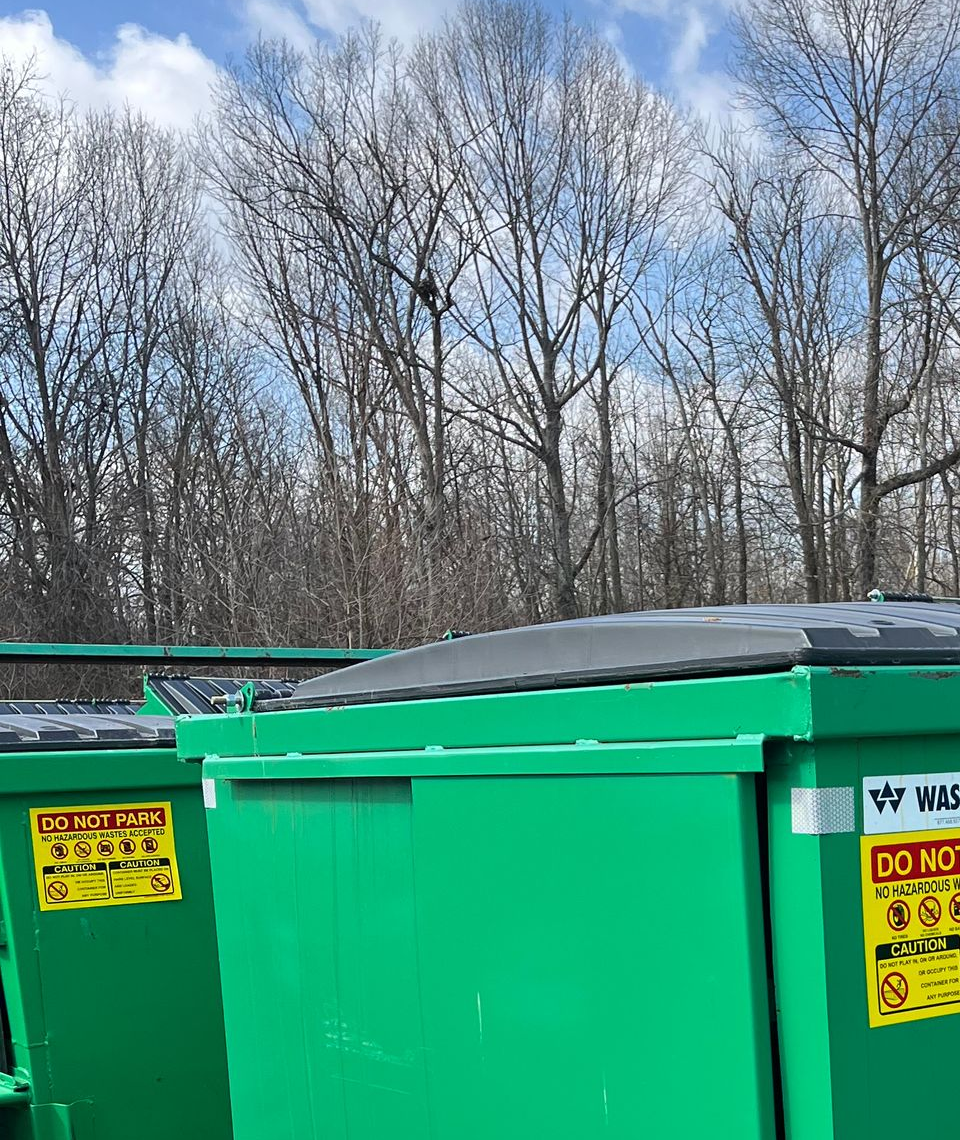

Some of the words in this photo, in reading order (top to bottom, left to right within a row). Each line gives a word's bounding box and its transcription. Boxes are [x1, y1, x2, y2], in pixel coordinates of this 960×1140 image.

[42, 816, 69, 831] DO
[74, 814, 110, 830] NOT
[116, 811, 162, 827] PARK
[54, 832, 98, 842] HAZARDOUS
[100, 830, 128, 839] WASTES
[130, 828, 165, 837] ACCEPTED
[54, 864, 96, 873] CAUTION
[120, 860, 160, 869] CAUTION
[877, 850, 913, 878] DO
[876, 886, 889, 899] NO
[892, 880, 950, 898] HAZARDOUS
[891, 937, 946, 956] CAUTION
[938, 990, 960, 998] PURPOSE
